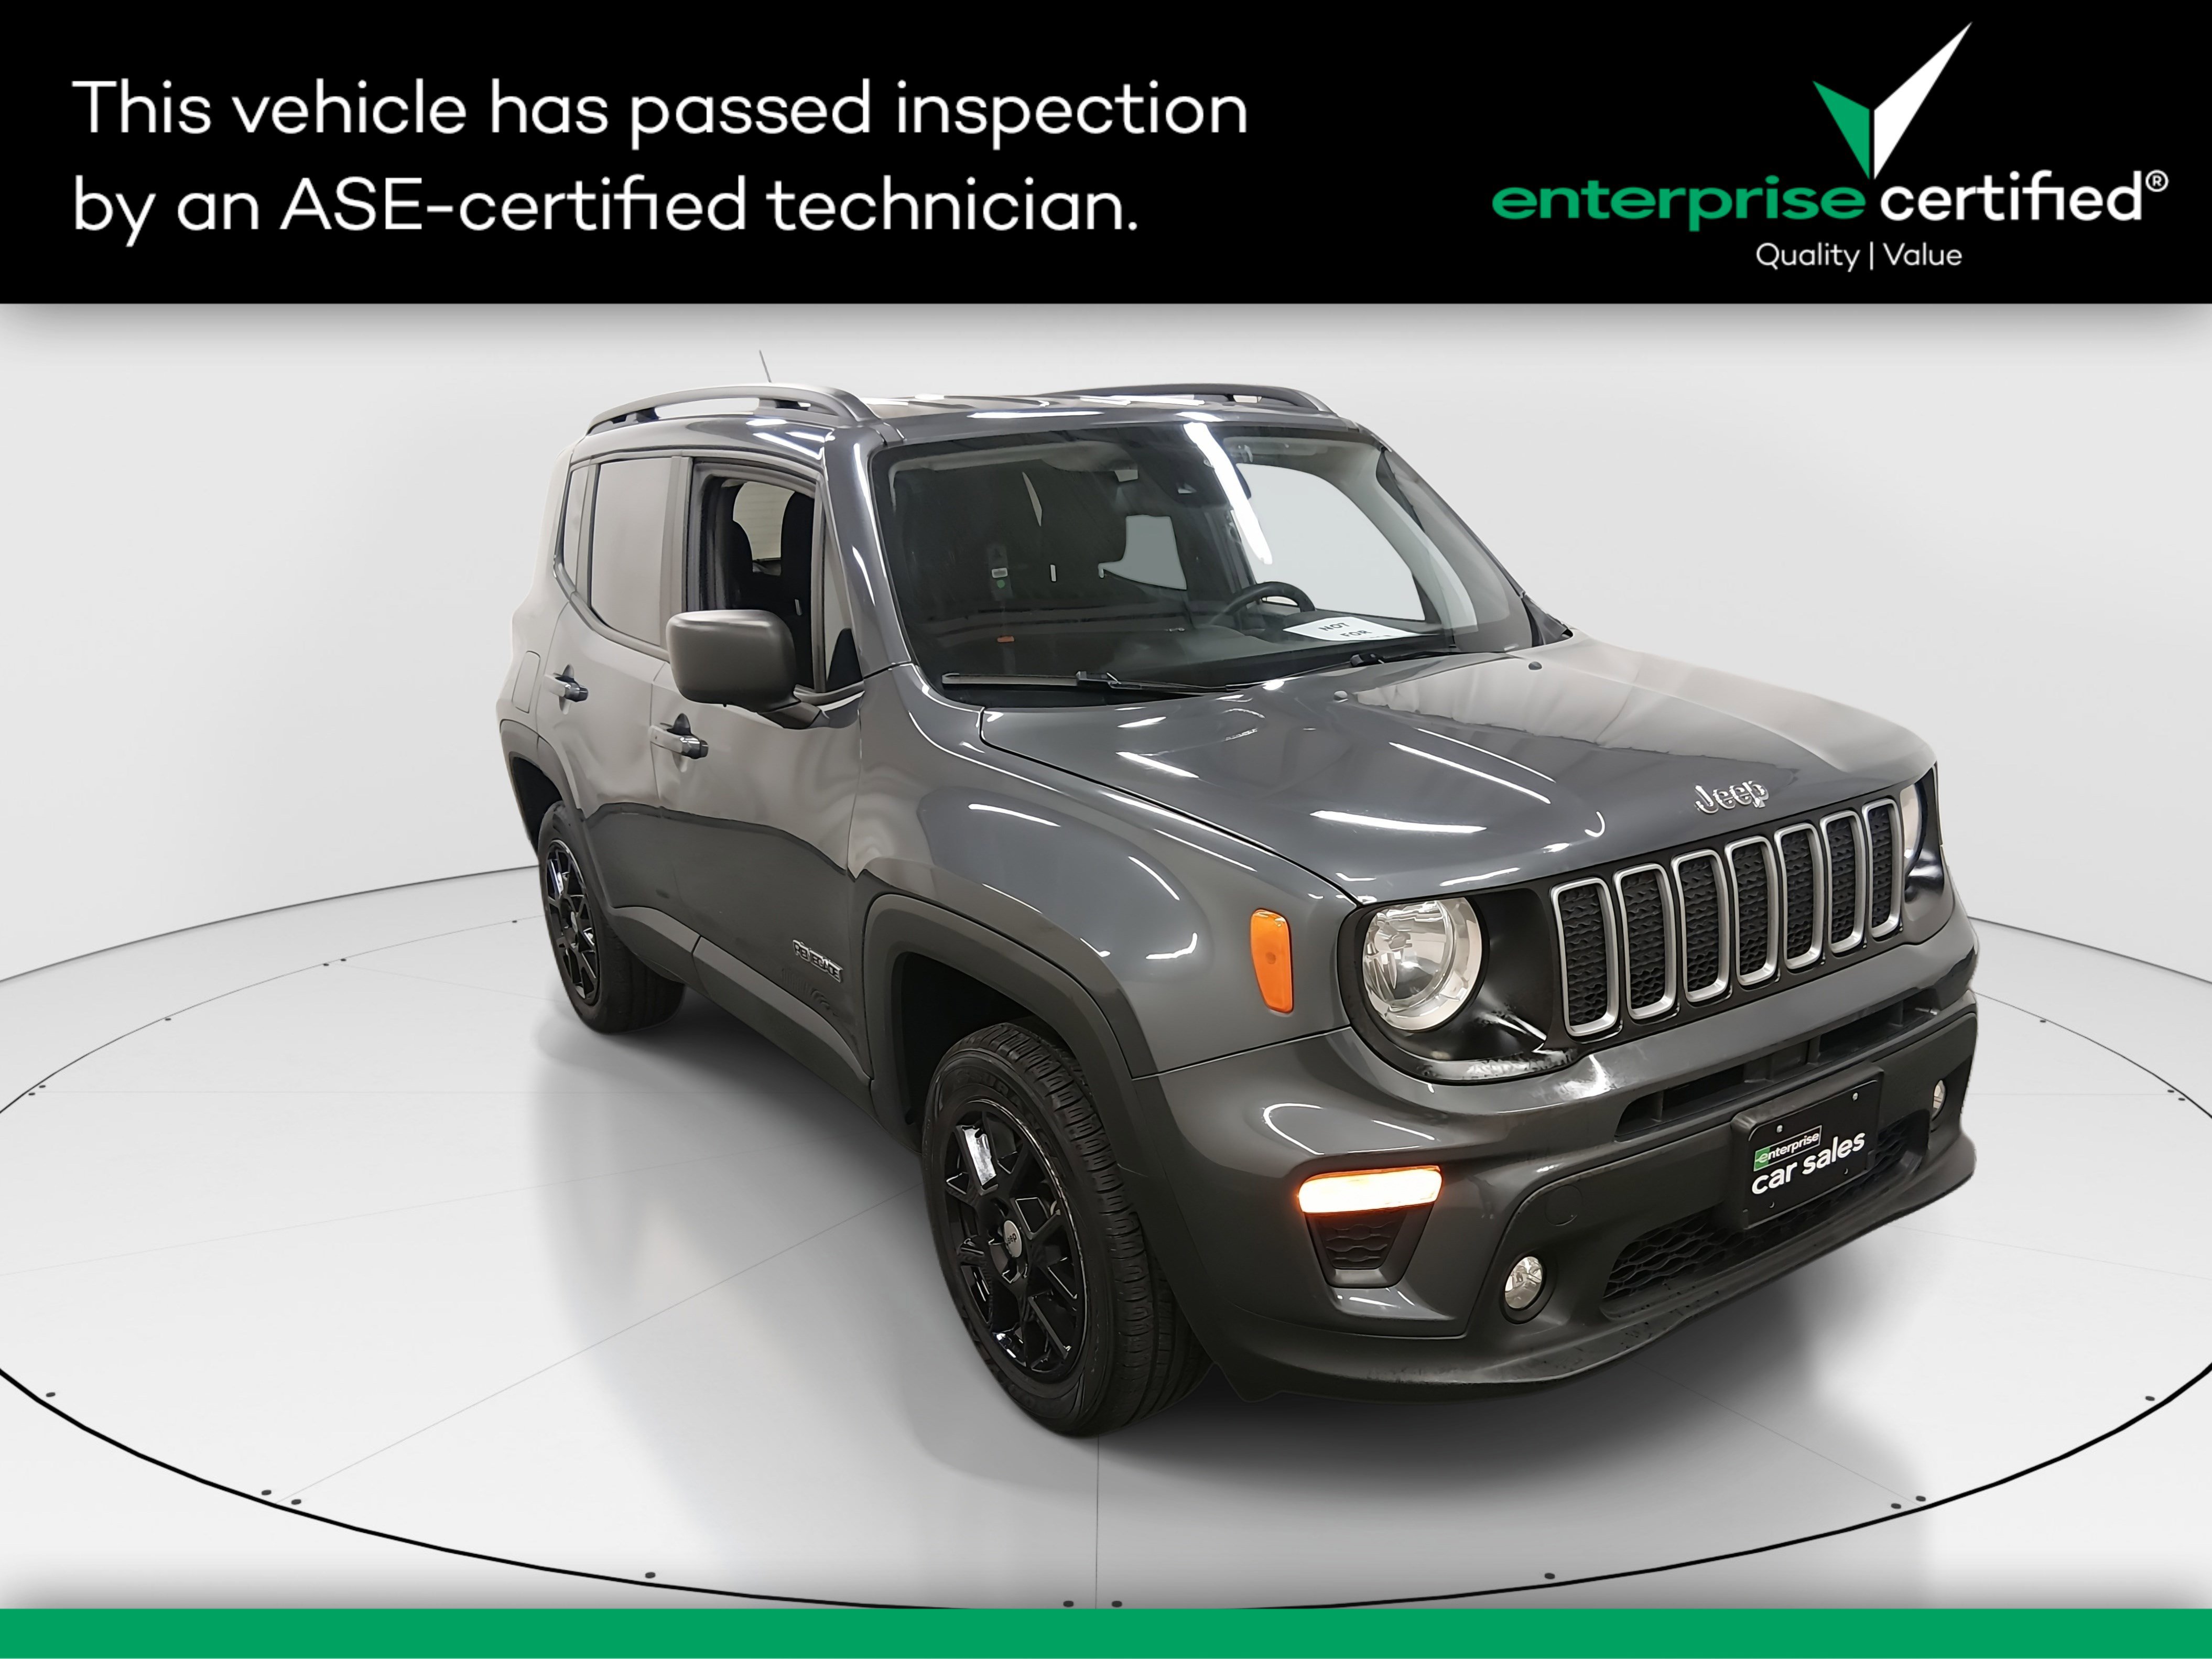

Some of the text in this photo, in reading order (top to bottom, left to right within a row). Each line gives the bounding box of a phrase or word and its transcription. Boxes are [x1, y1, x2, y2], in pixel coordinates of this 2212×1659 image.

[1318, 622, 1351, 632] NOT
[1694, 780, 1770, 814] Jeep
[1751, 1132, 1866, 1195] car sales
[1755, 1132, 1819, 1163] enterprise
